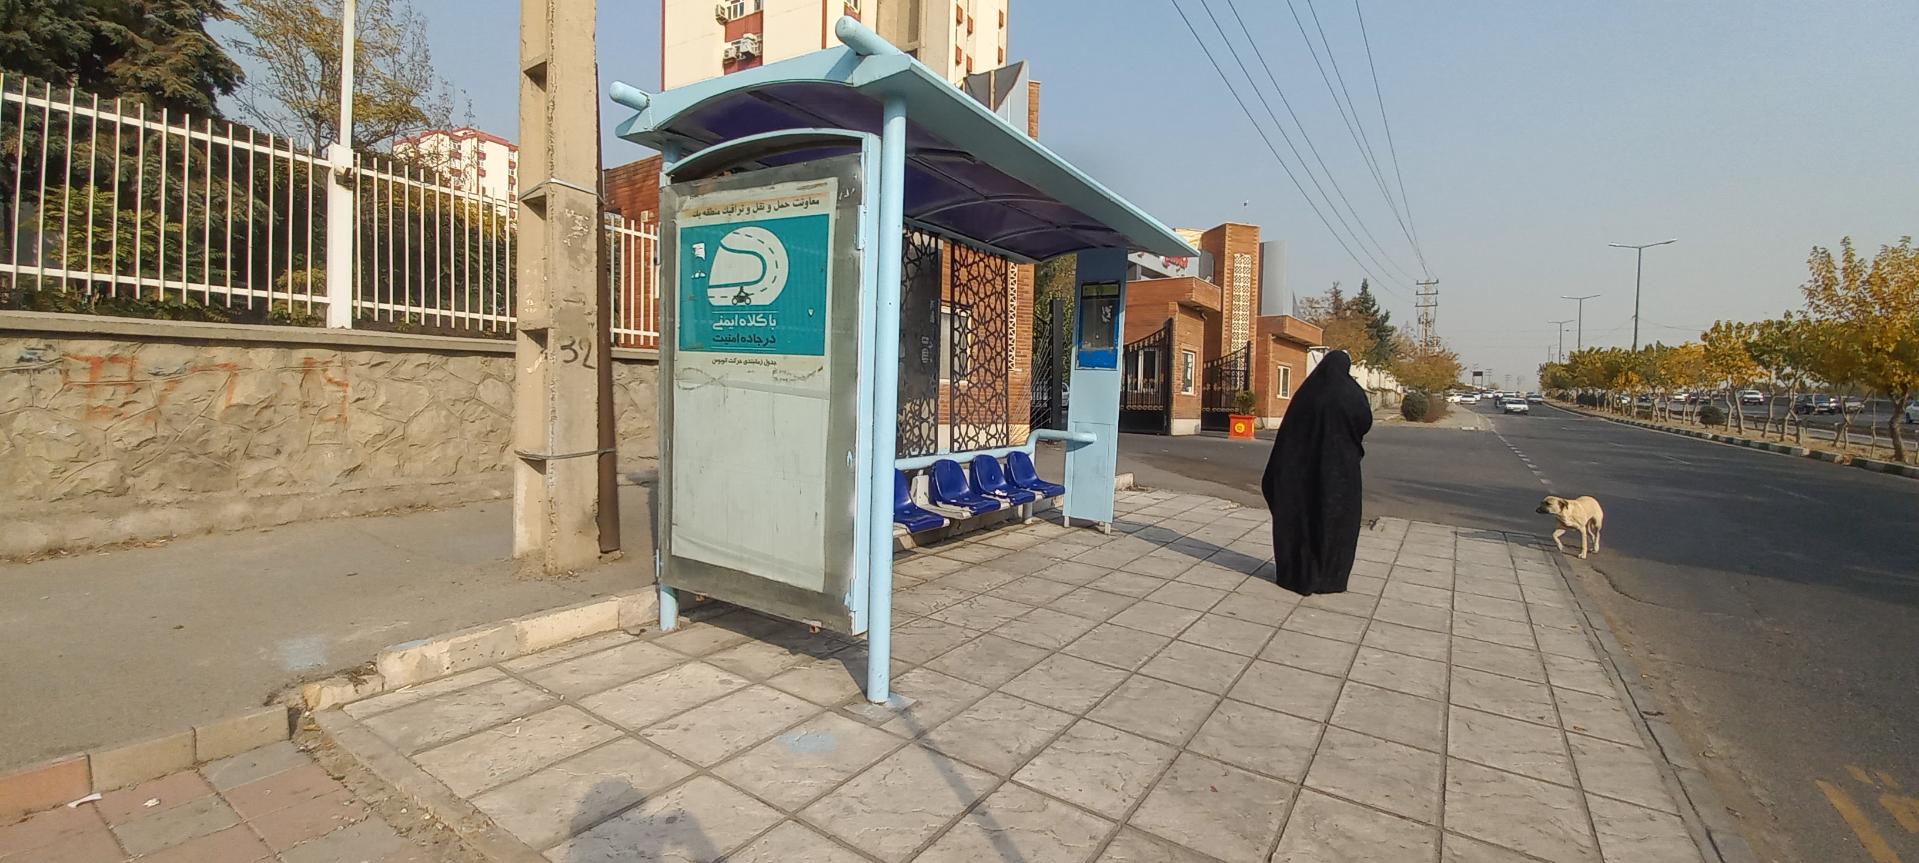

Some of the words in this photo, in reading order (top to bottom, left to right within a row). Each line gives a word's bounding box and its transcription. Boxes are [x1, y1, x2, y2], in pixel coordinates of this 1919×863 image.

[752, 202, 765, 213] نقل
[766, 204, 772, 213] و
[773, 201, 790, 211] حمل
[792, 197, 820, 209] معاونت
[702, 207, 720, 216] منطقه
[745, 206, 751, 215] و
[712, 313, 738, 331] ایمنی
[739, 313, 768, 327] کلاه
[768, 313, 777, 330] با
[712, 332, 740, 346] امنیت
[740, 333, 764, 347] جاده
[762, 334, 777, 347] در
